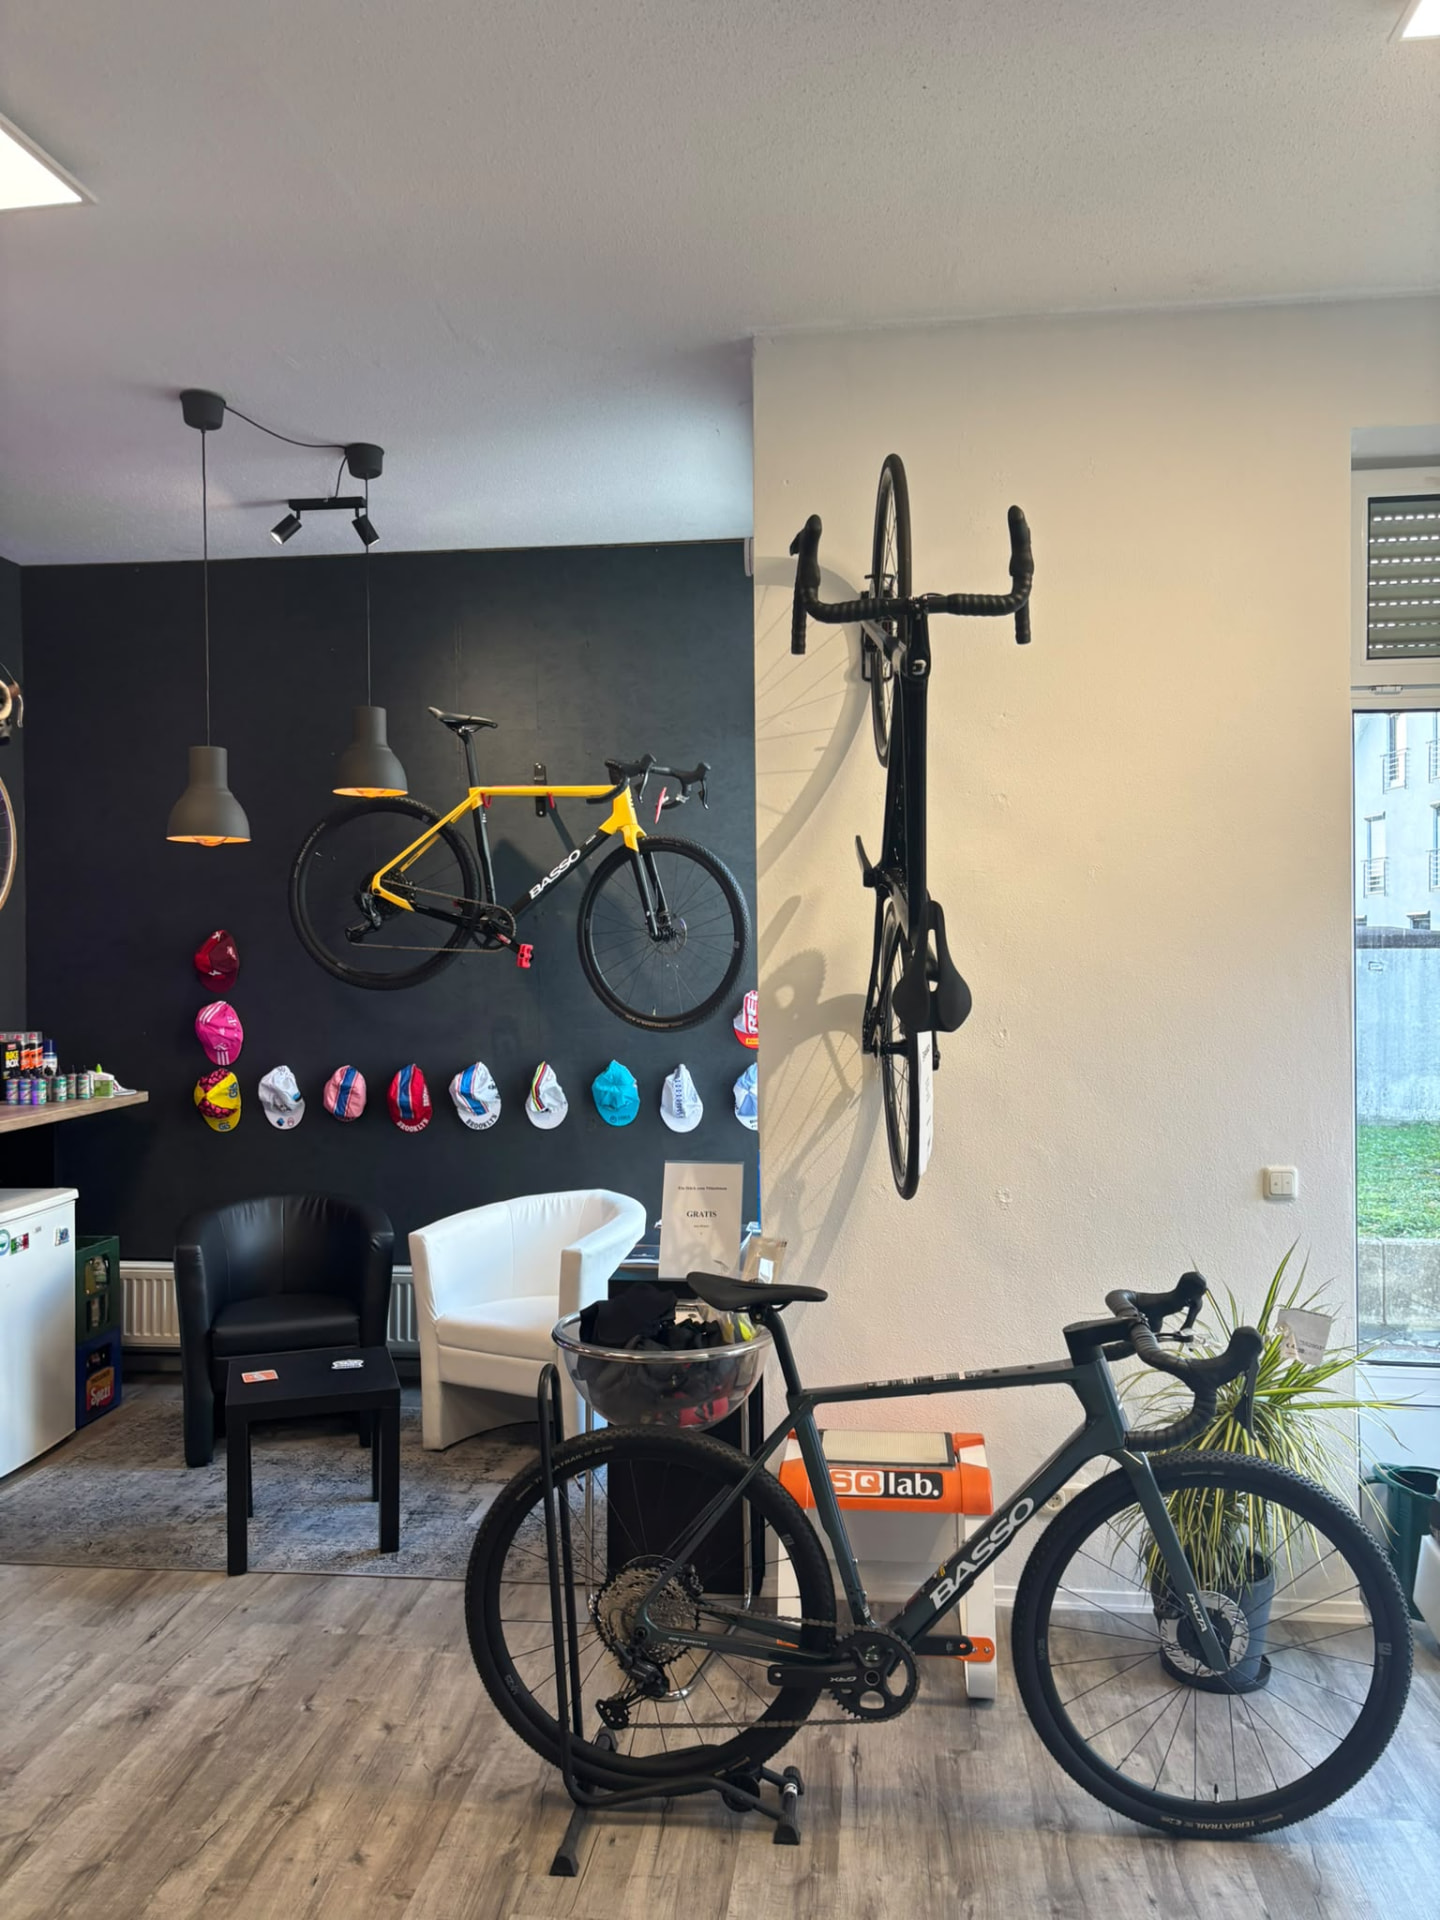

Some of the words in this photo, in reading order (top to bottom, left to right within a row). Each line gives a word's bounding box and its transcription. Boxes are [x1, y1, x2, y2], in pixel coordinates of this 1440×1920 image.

[528, 848, 581, 900] BASSO
[396, 1118, 429, 1132] BROOKLYN
[465, 1114, 497, 1130] BROOKLYN
[686, 1210, 717, 1218] GRATIS
[929, 1497, 1034, 1610] BASSO
